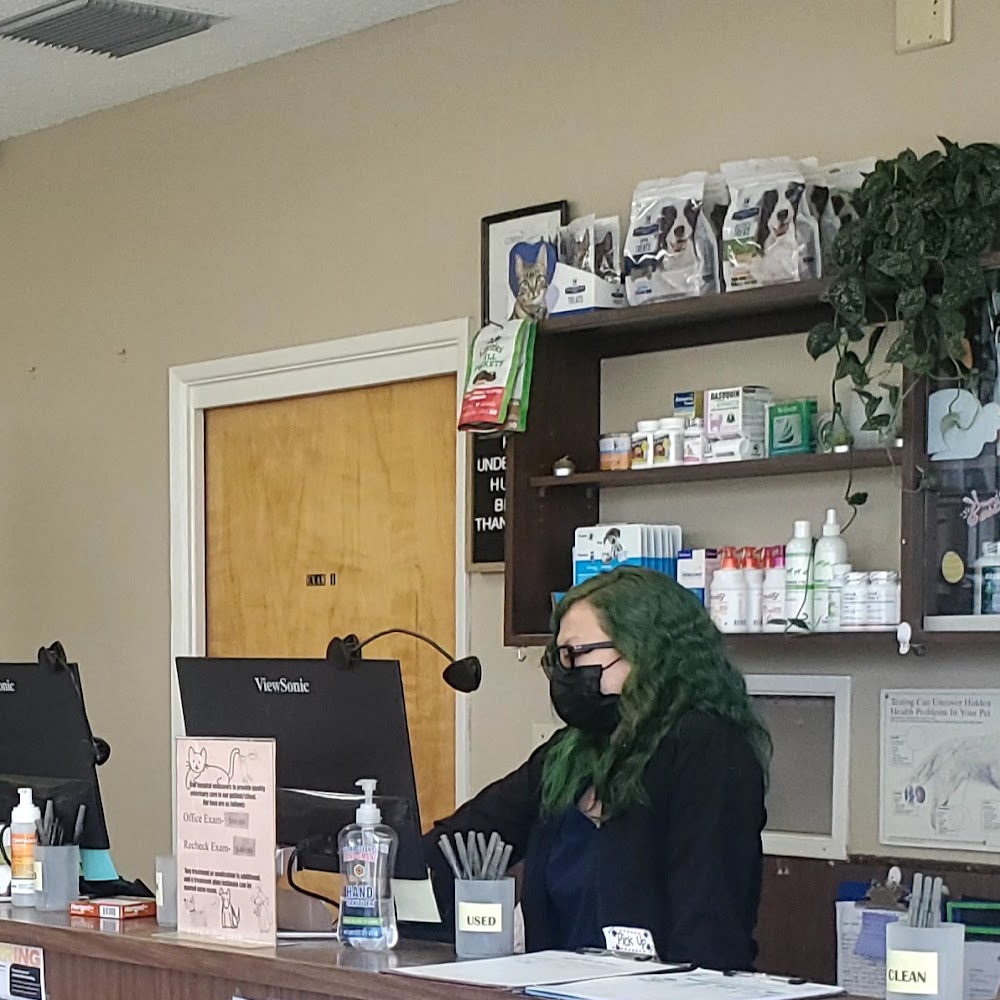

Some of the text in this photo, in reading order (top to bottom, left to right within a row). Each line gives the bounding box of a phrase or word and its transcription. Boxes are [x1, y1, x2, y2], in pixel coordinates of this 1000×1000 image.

[254, 677, 310, 694] ViewSonic
[932, 699, 962, 707] Uncover
[964, 700, 991, 708] Hidden
[891, 708, 914, 716] Health
[979, 710, 991, 718] Pet
[183, 812, 224, 824] Office Exam-
[183, 840, 231, 852] Recheck Exam-
[346, 884, 373, 898] HAND
[466, 914, 496, 928] USED
[618, 932, 647, 950] Pick Up
[888, 968, 926, 984] CLEAN
